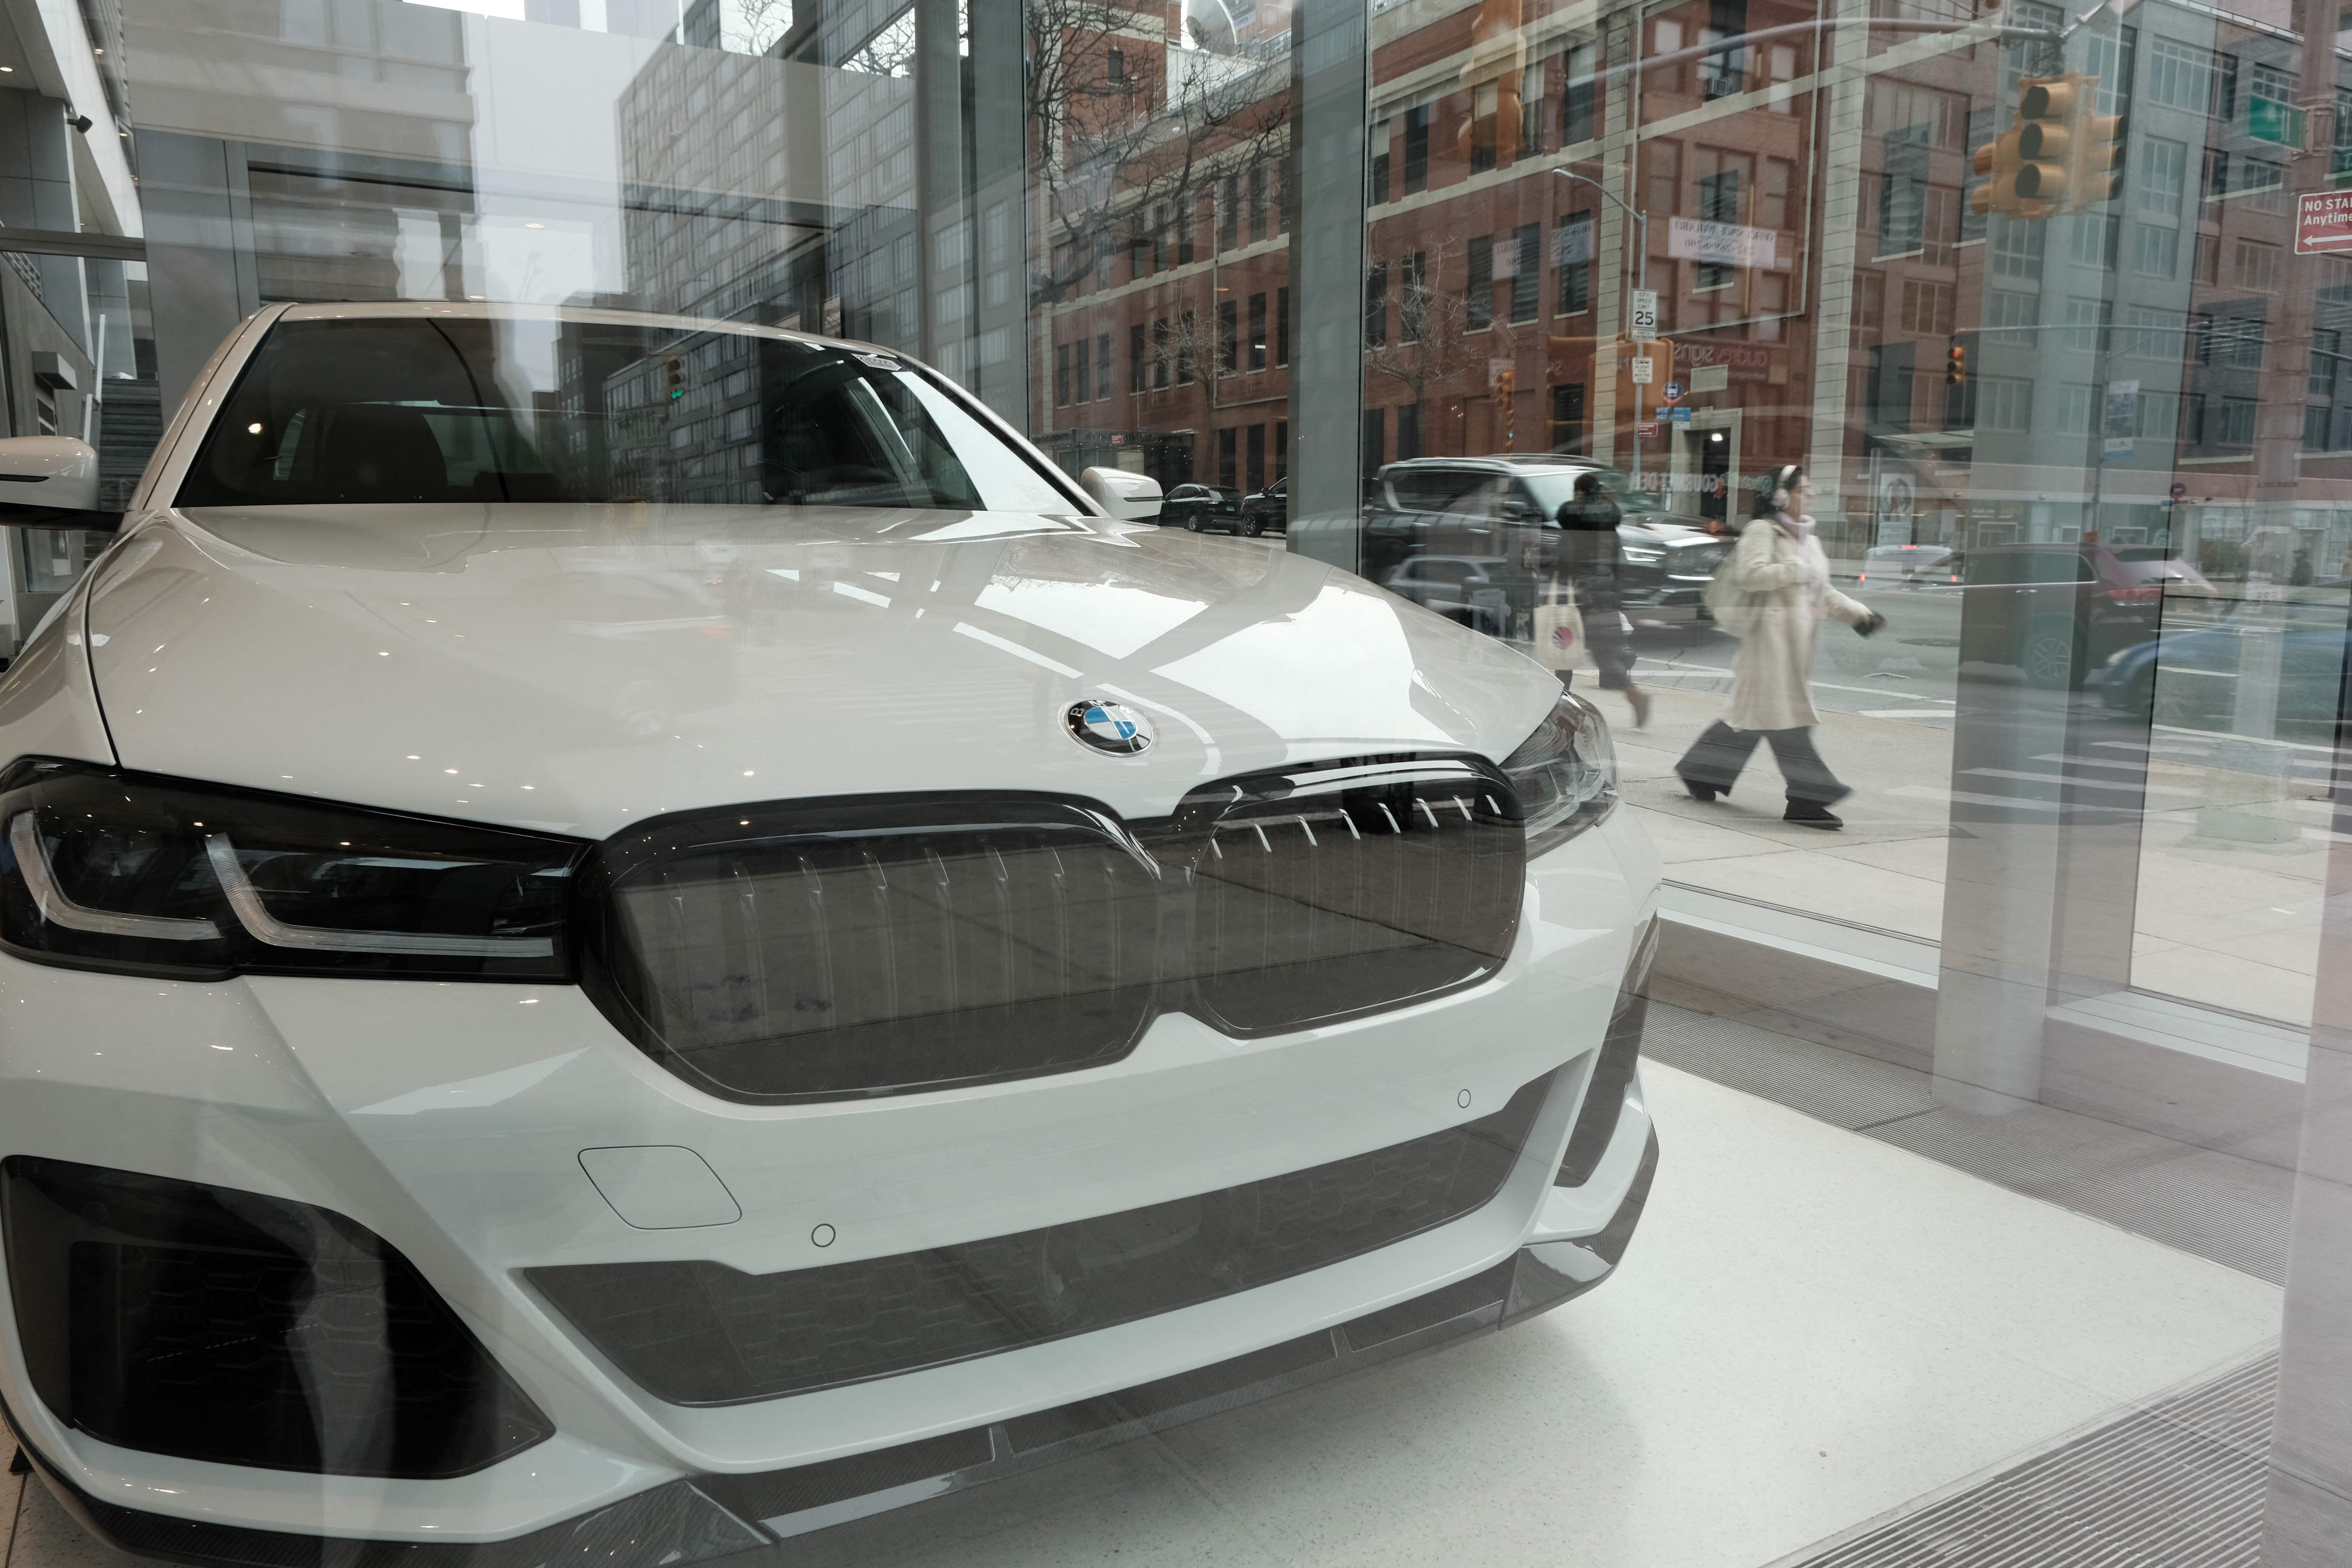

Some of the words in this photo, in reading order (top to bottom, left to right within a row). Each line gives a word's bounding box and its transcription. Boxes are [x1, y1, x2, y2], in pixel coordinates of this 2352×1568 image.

[2305, 200, 2322, 212] NO
[2303, 212, 2352, 227] Anytime
[1635, 311, 1654, 325] 25
[1070, 700, 1134, 717] BMW
